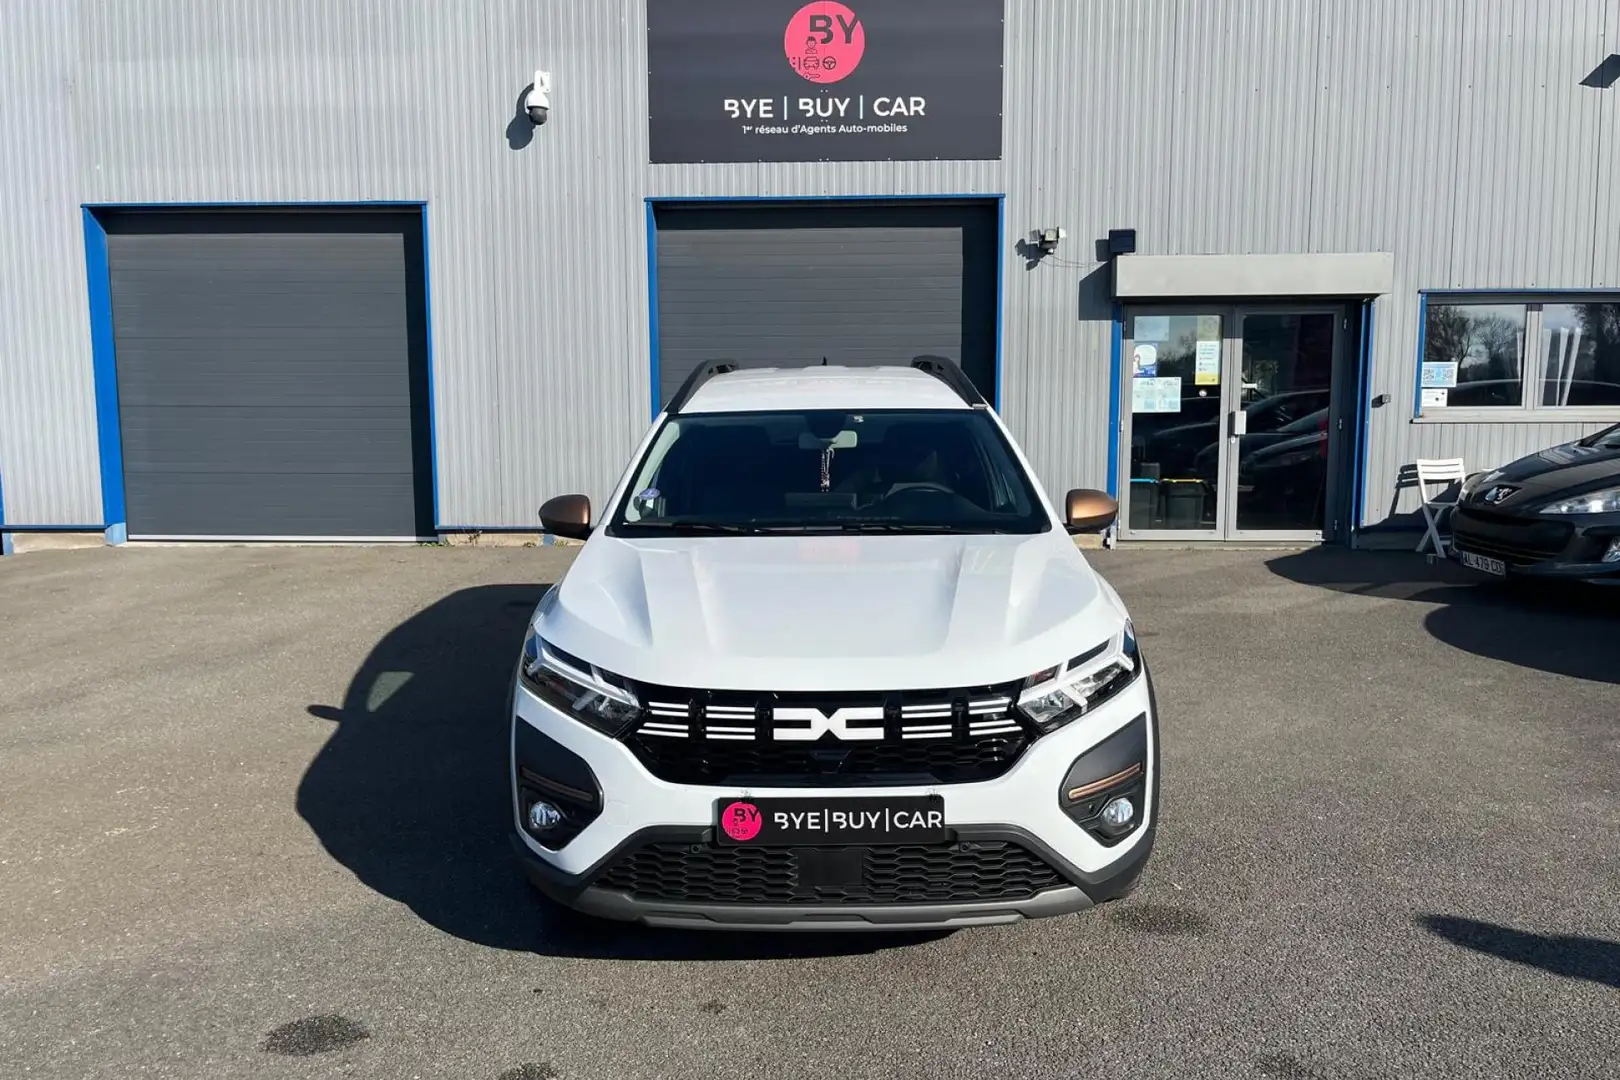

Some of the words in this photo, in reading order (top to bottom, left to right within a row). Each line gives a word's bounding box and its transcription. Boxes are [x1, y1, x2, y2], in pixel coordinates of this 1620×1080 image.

[809, 14, 858, 45] BY
[724, 98, 774, 119] BYE
[799, 97, 851, 118] BUY
[873, 96, 926, 117] CAR
[755, 124, 789, 135] réseau
[838, 123, 908, 134] Auto-mobiles
[734, 808, 760, 823] BY
[893, 810, 943, 829] CAR
